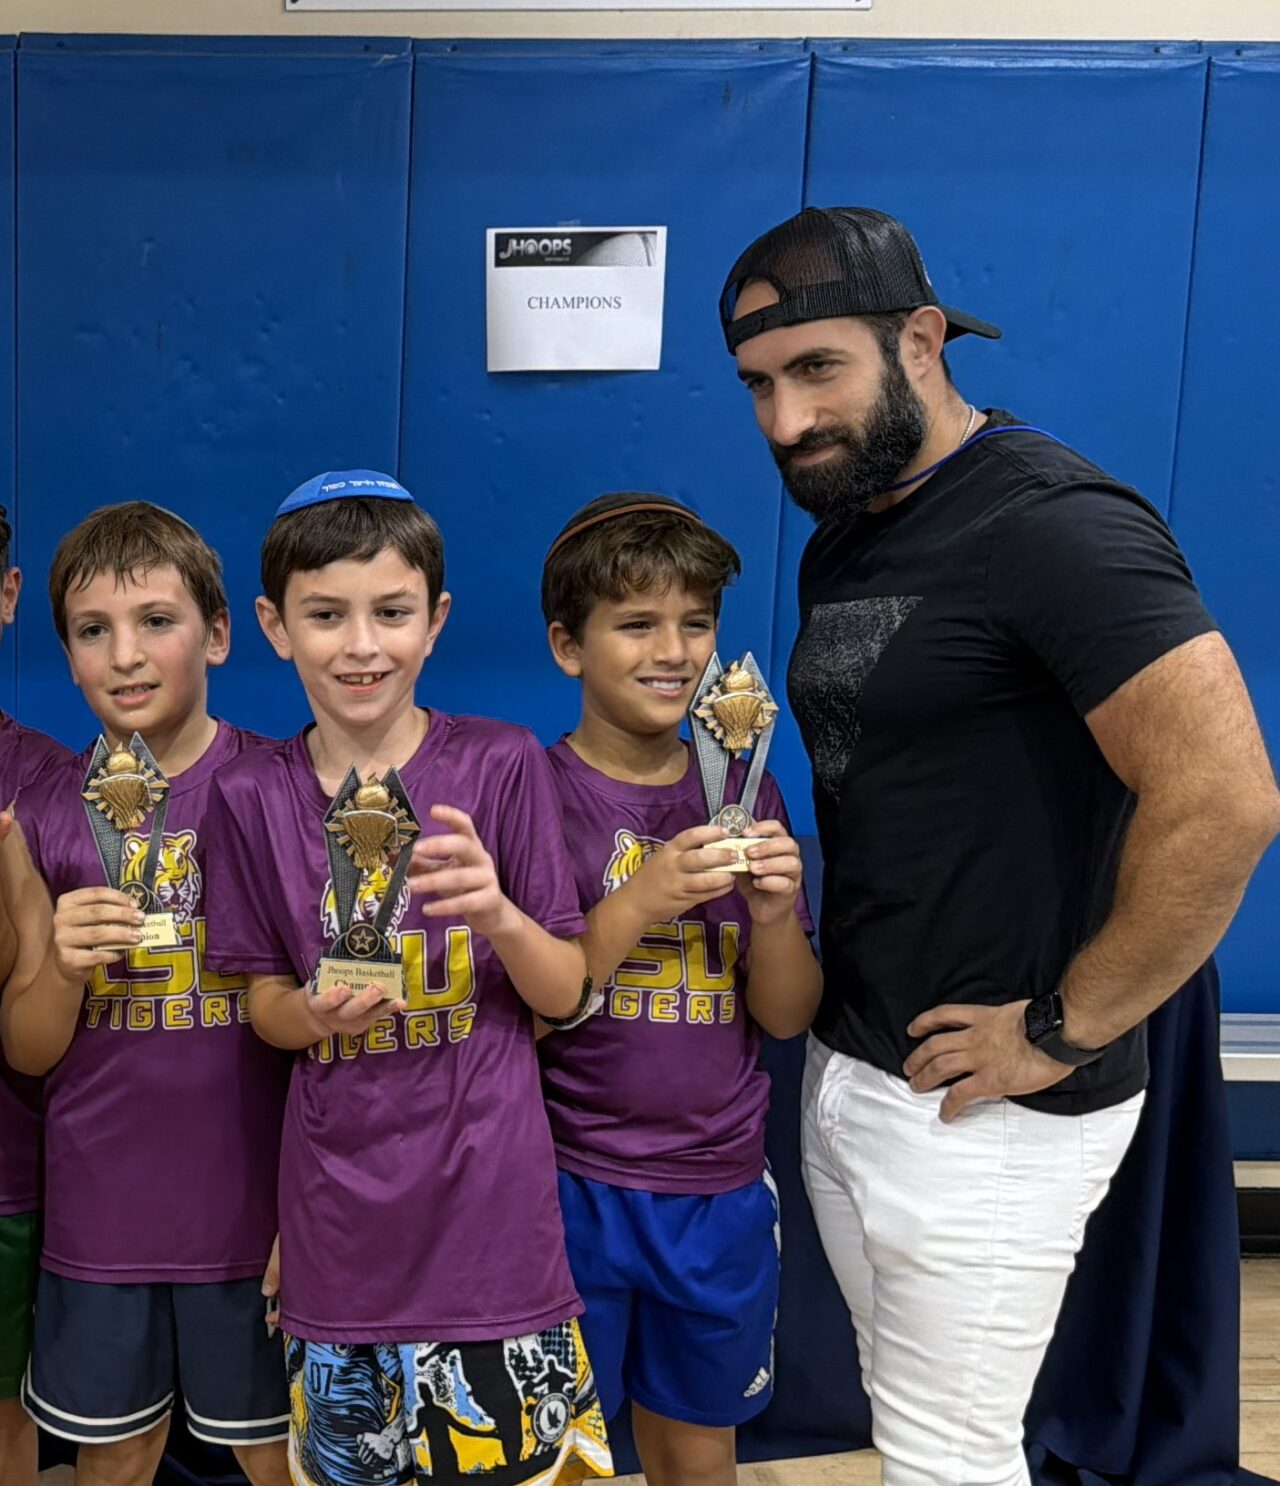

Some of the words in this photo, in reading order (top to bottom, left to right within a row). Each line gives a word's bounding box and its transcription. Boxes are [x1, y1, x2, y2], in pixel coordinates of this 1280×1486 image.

[499, 238, 572, 260] JHOOPS
[527, 296, 622, 310] CHAMPIONS
[612, 920, 738, 992] SU
[355, 967, 395, 979] Basketball
[610, 989, 737, 1024] GERS
[310, 1361, 334, 1397] 07
